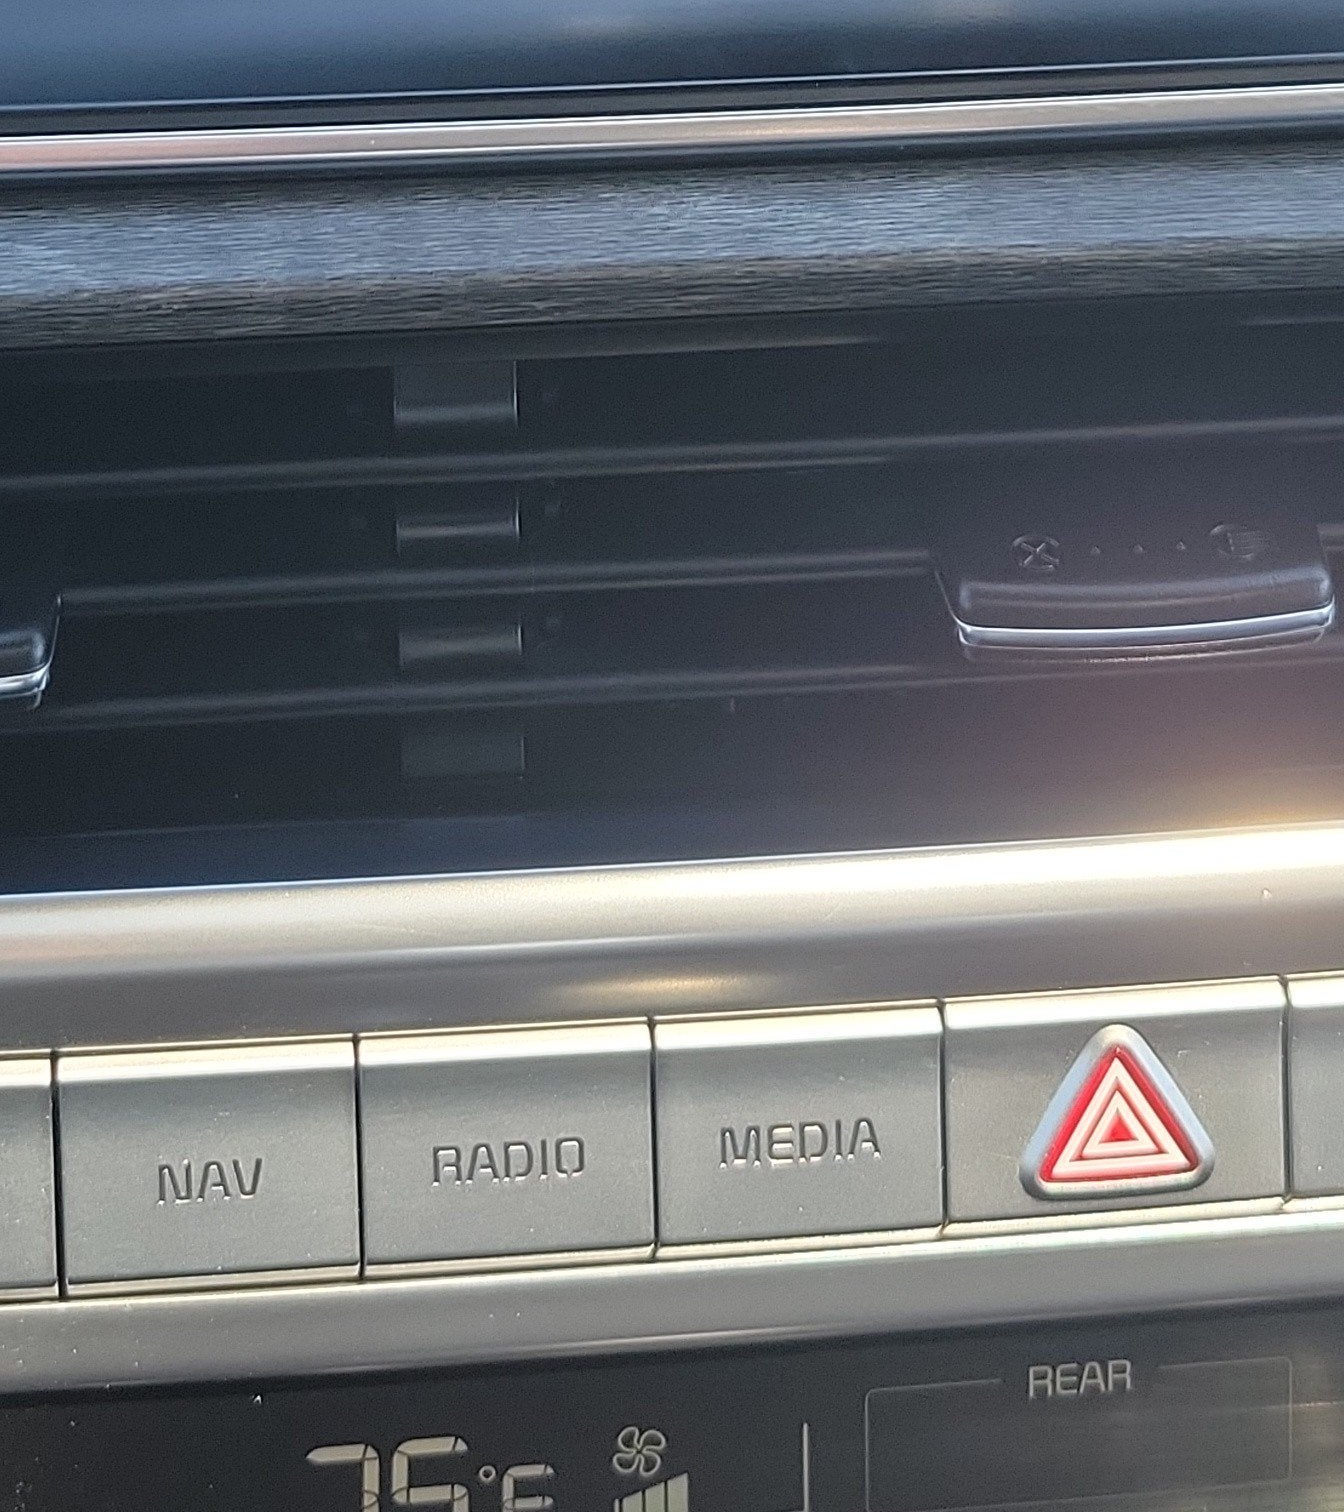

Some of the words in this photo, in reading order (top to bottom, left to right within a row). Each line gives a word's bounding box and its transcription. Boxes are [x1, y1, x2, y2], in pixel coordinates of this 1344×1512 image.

[432, 1136, 586, 1187] RADIO
[719, 1117, 881, 1170] MEDIA
[157, 1157, 263, 1205] NAV
[1028, 1358, 1133, 1400] REAR
